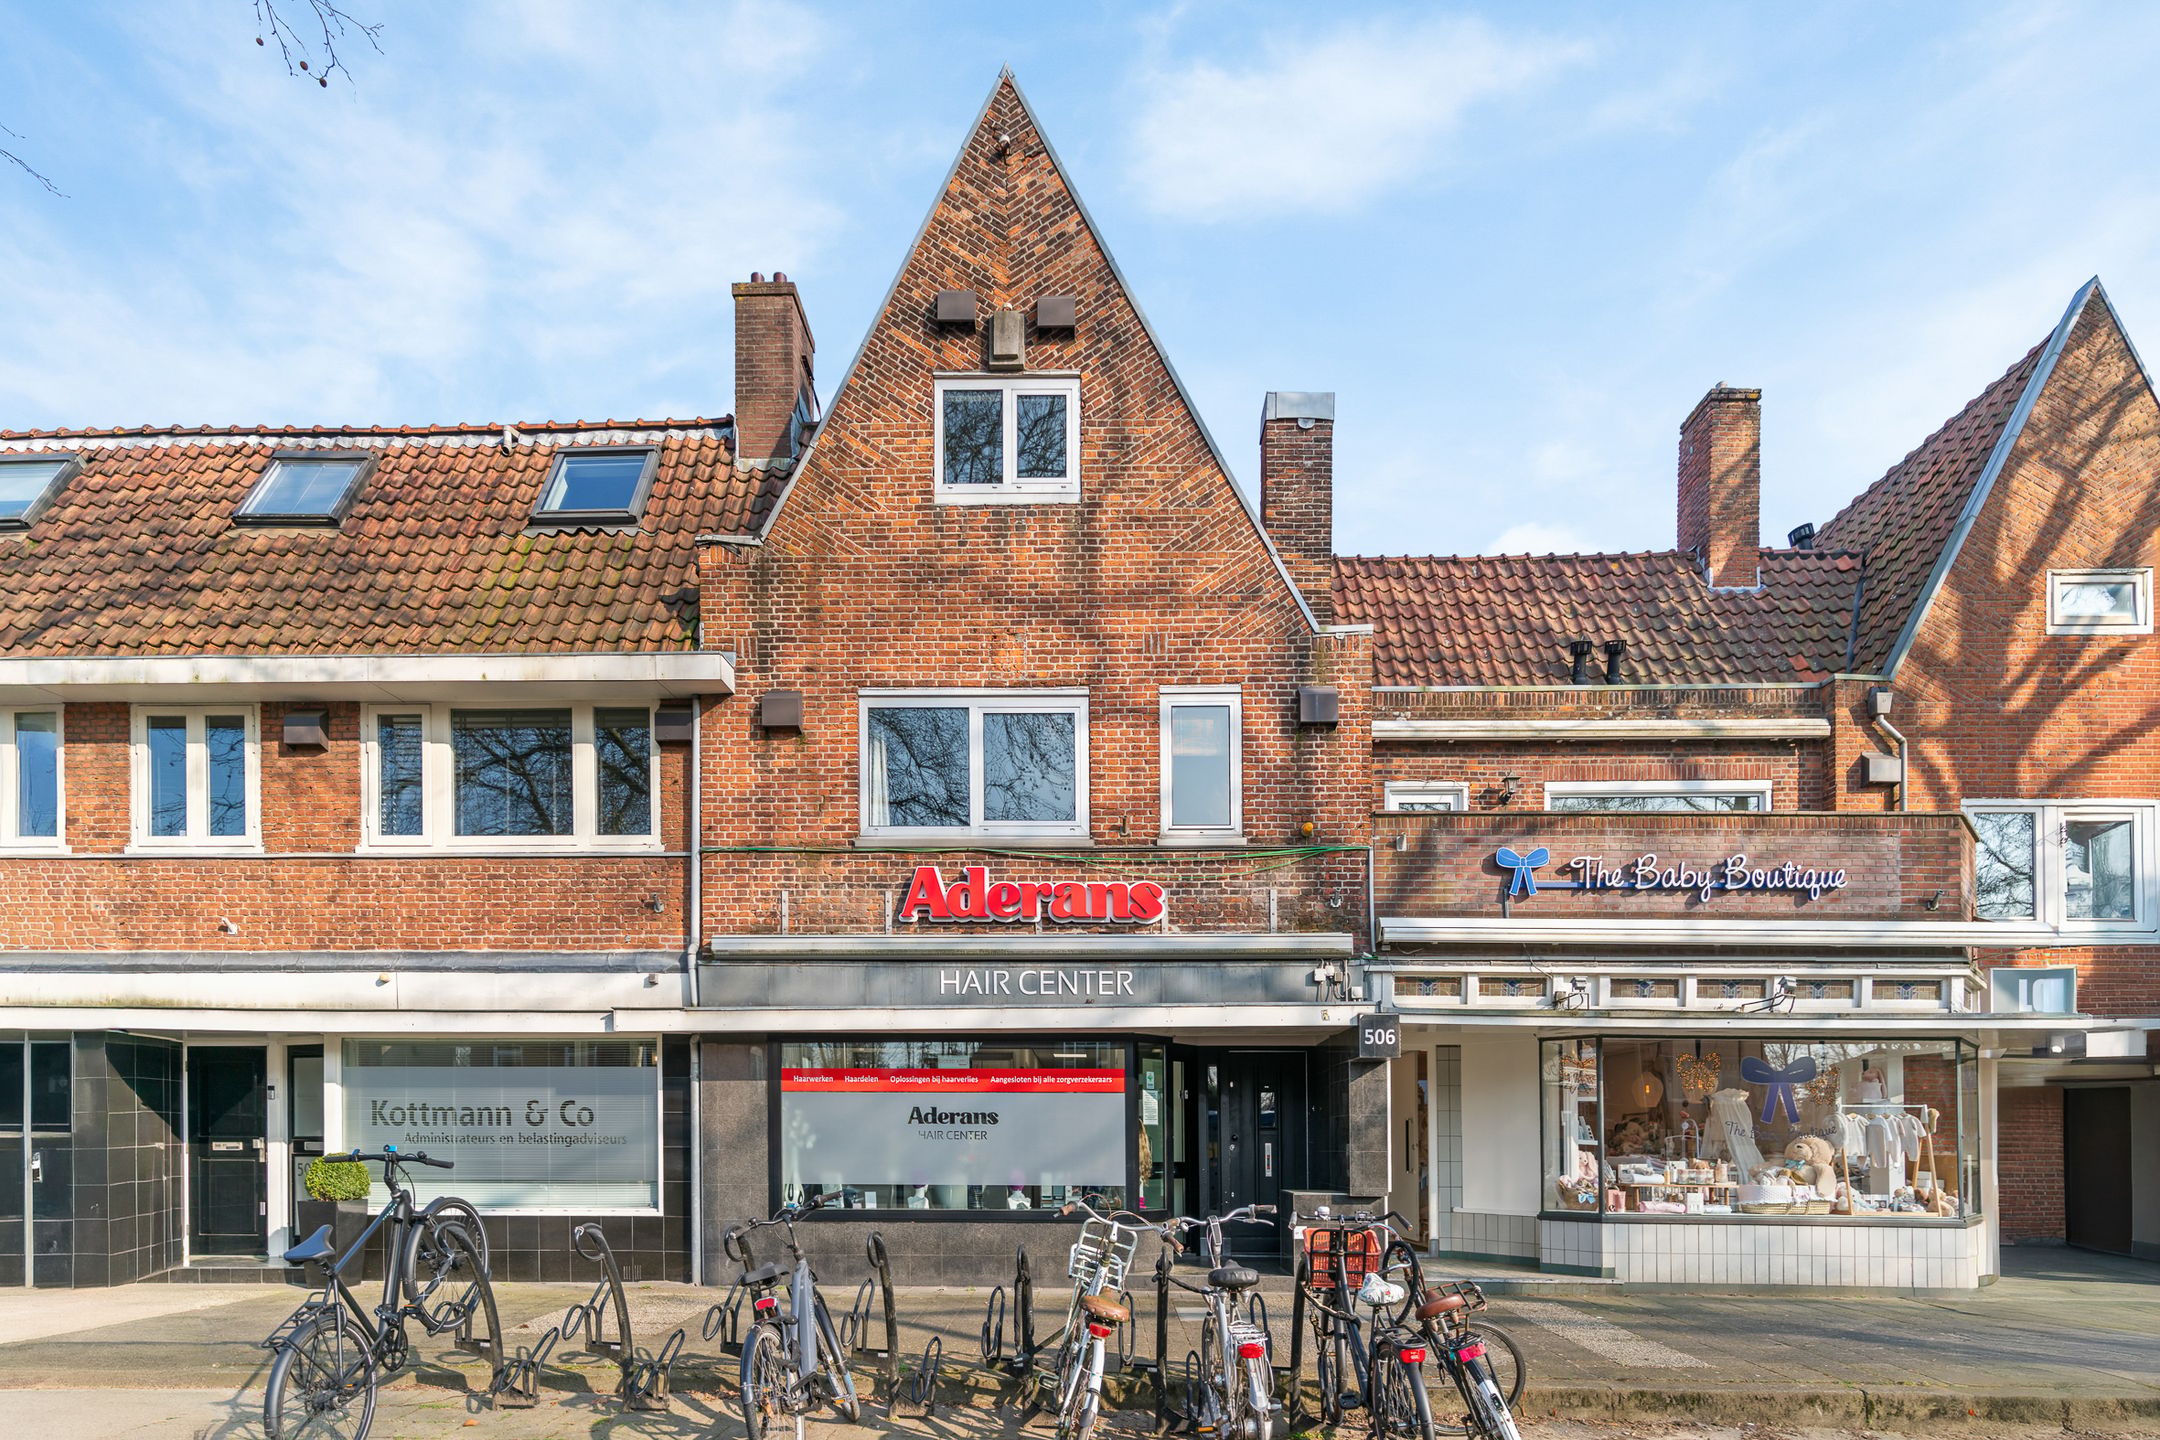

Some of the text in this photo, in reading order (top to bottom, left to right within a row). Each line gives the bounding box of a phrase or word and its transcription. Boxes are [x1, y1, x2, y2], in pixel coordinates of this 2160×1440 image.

[1570, 853, 1849, 902] The Baby Boutique
[899, 866, 1165, 923] Aderans
[940, 970, 1134, 995] HAIR CENTER
[1364, 1028, 1396, 1045] 506
[793, 1075, 834, 1083] Haarwerken
[844, 1075, 879, 1083] Haardelen
[889, 1075, 979, 1085] Oplossingen bij haarverlies
[990, 1075, 1113, 1085] Aangesloten bij alle zorgverzekeraars
[371, 1099, 595, 1127] Kottmann & Co
[907, 1106, 999, 1125] Aderans
[918, 1130, 988, 1140] HAIR CENTER
[1725, 1121, 1747, 1137] The
[404, 1132, 628, 1148] Administrateurs en belastingadviseurs
